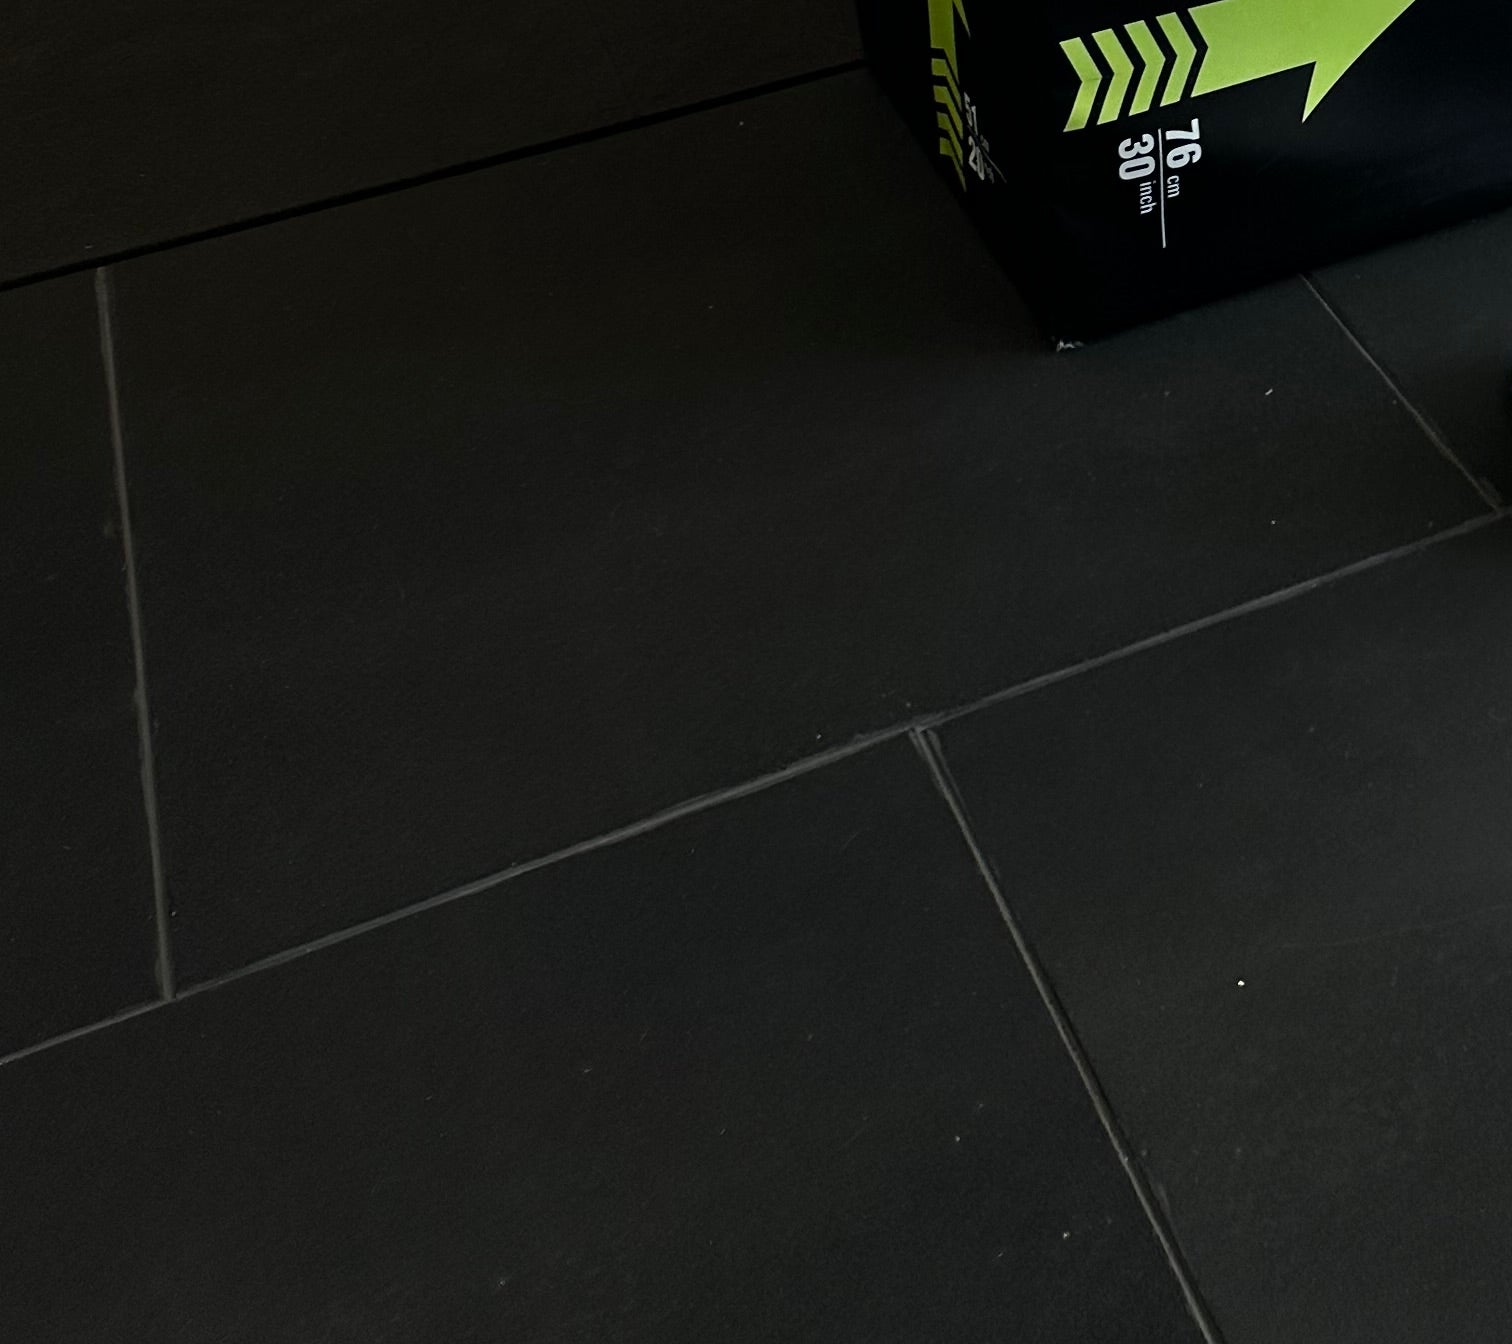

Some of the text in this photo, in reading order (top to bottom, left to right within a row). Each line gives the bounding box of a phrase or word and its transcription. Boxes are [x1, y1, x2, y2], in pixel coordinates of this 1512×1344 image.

[1118, 133, 1157, 215] 30 inch
[1165, 118, 1202, 199] 76 cm
